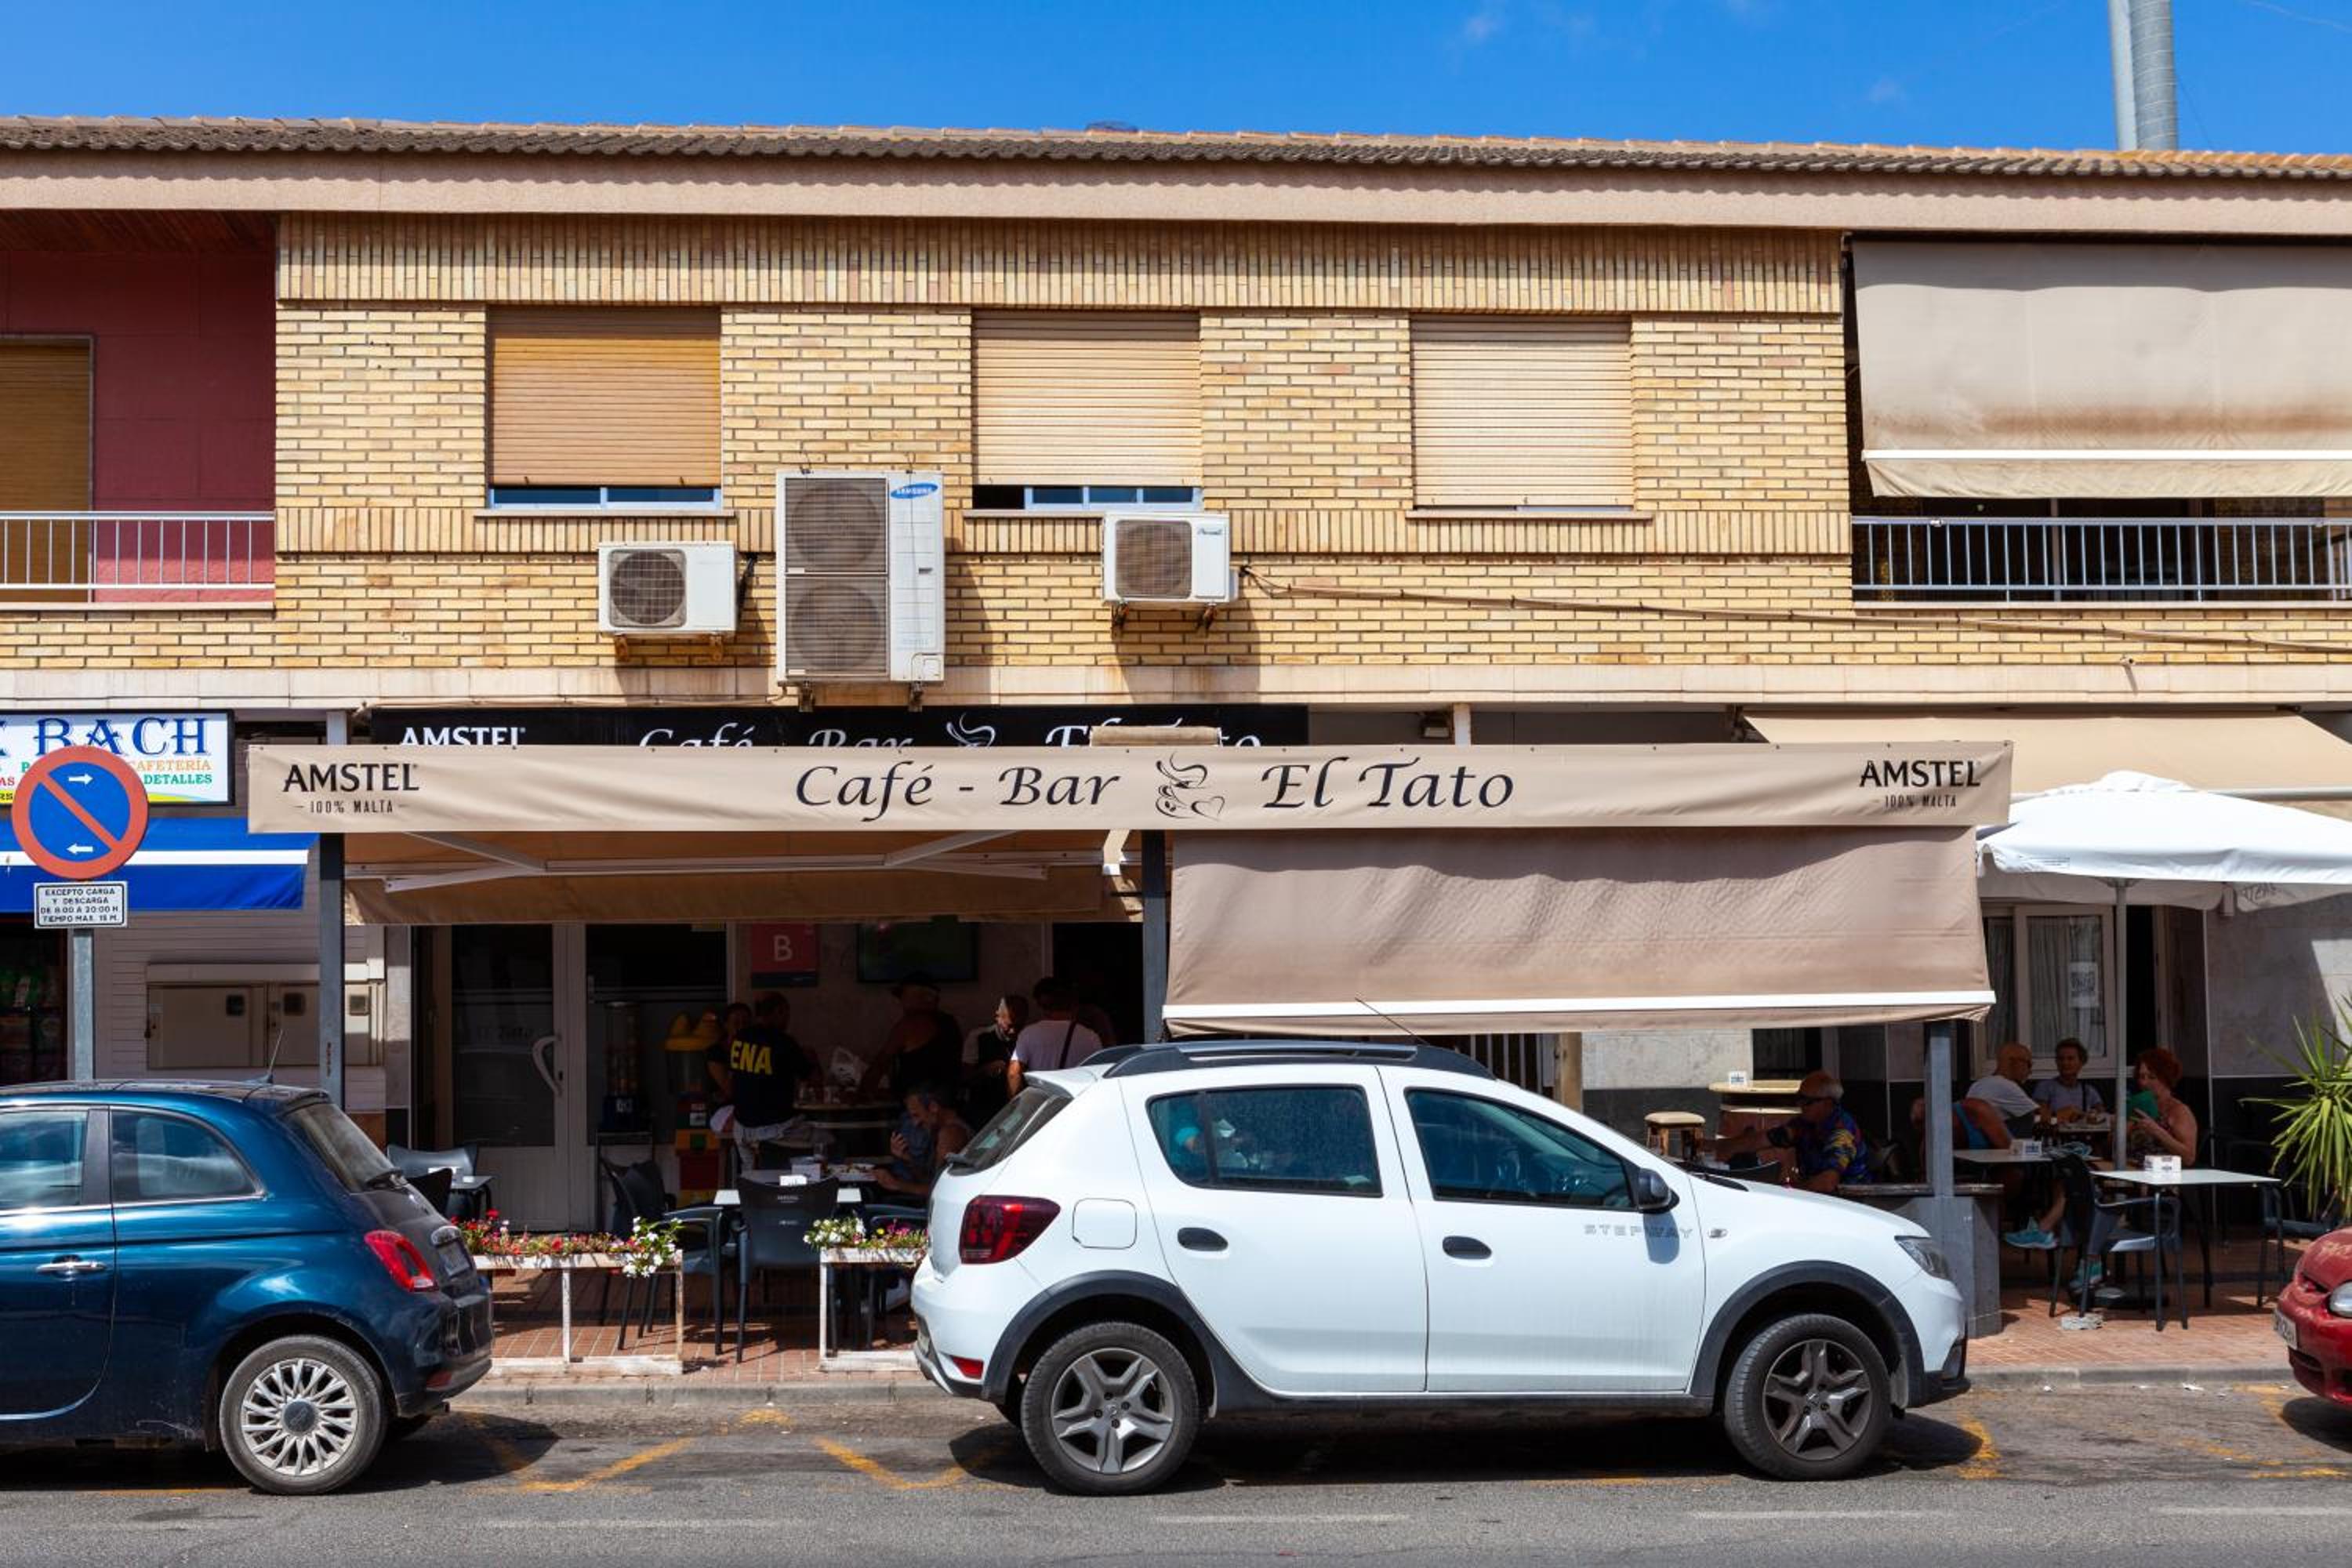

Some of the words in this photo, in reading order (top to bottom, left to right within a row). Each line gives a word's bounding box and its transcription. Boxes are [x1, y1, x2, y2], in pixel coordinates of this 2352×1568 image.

[34, 717, 209, 756] BACH
[144, 774, 212, 785] DETALLES
[283, 763, 419, 792] AMSTEL
[1860, 760, 1981, 787] AMSTEL
[797, 761, 933, 822] Café
[998, 767, 1120, 806] Bar
[1261, 757, 1349, 808] El
[1359, 757, 1514, 808] Tato
[1886, 794, 1914, 808] 100%
[1922, 793, 1957, 808] MALTA
[310, 800, 345, 814] 100%
[354, 800, 393, 814] MALTA
[85, 887, 116, 895] CARGA
[773, 934, 793, 962] B
[730, 1038, 773, 1076] ENA
[1584, 1225, 1693, 1239] STEPWAY
